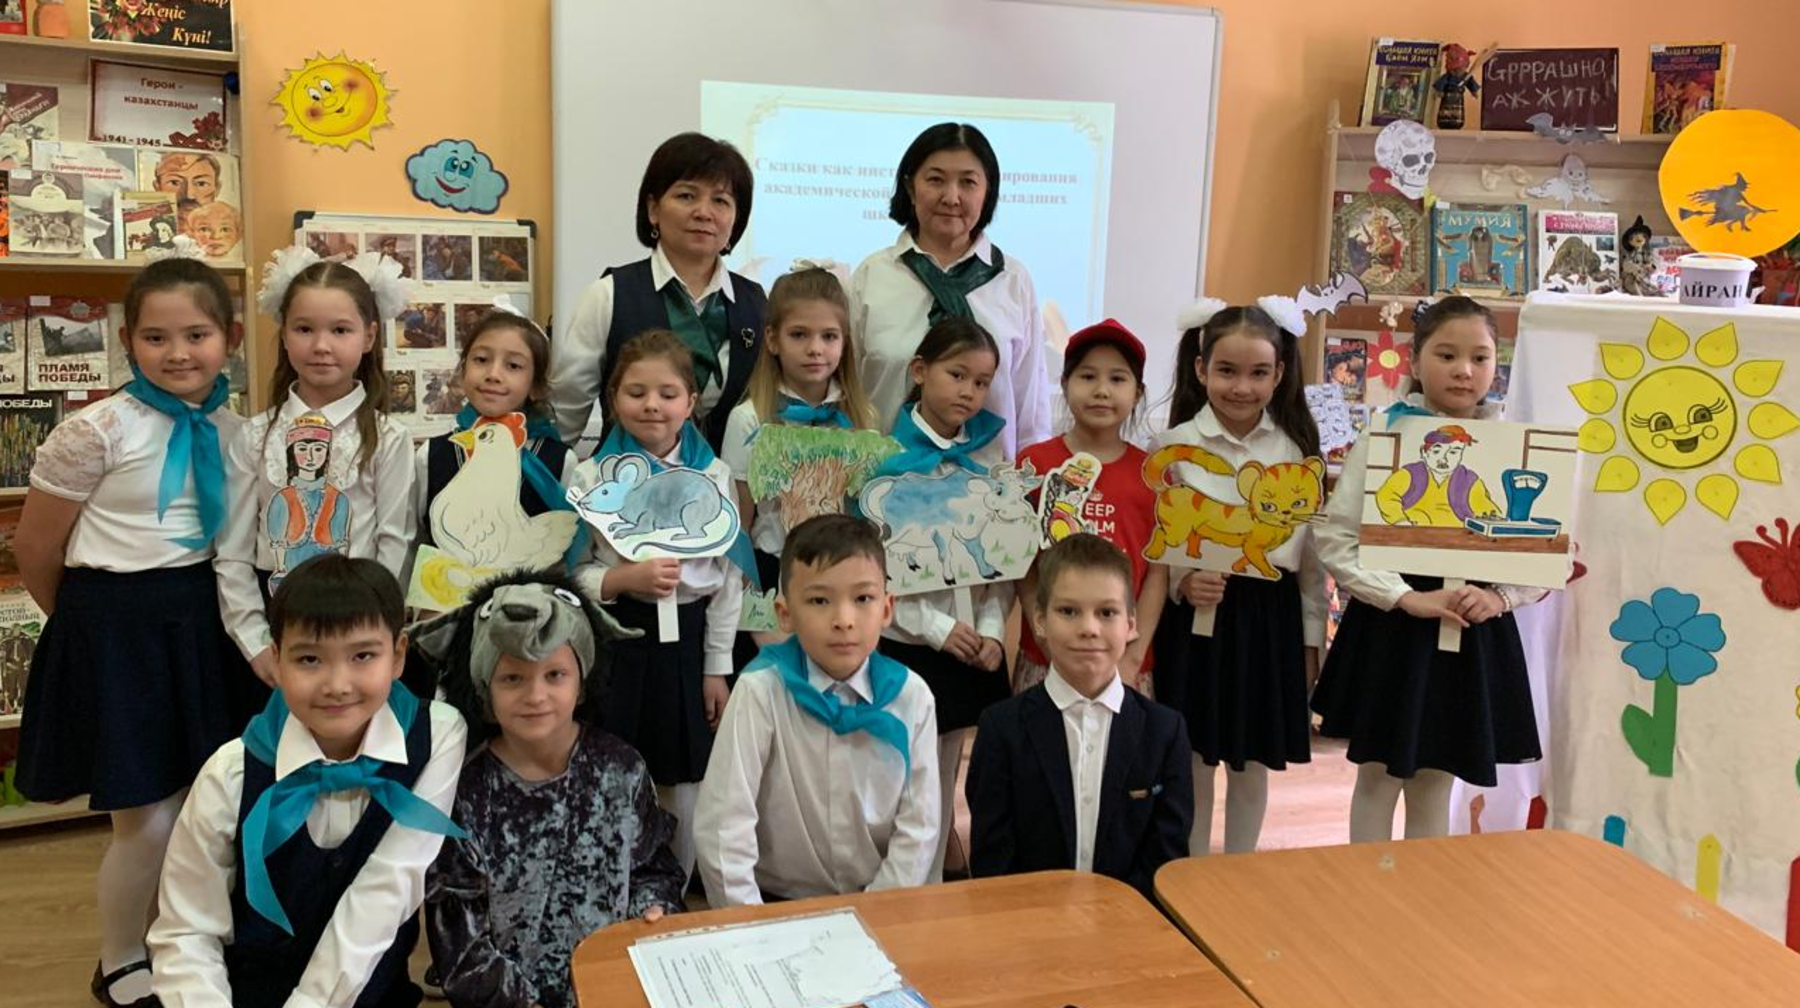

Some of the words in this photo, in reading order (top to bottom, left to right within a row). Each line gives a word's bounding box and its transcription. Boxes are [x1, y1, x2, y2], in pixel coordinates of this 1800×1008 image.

[140, 3, 187, 21] Жеңіс
[172, 27, 212, 45] Күні!
[141, 77, 176, 91] Герои
[124, 95, 199, 111] казахстанцы
[102, 134, 127, 144] 1941
[136, 137, 162, 148] 1945
[755, 157, 817, 175] Сказки
[822, 163, 854, 176] как
[1001, 171, 1078, 186] ирования
[764, 182, 892, 200] академической
[1448, 214, 1512, 228] МУМИЯ
[1682, 281, 1743, 299] АЙРАН
[38, 362, 90, 373] ПЛАМЯ
[38, 373, 101, 384] ПОБЕДЫ
[1085, 502, 1116, 517] EEP
